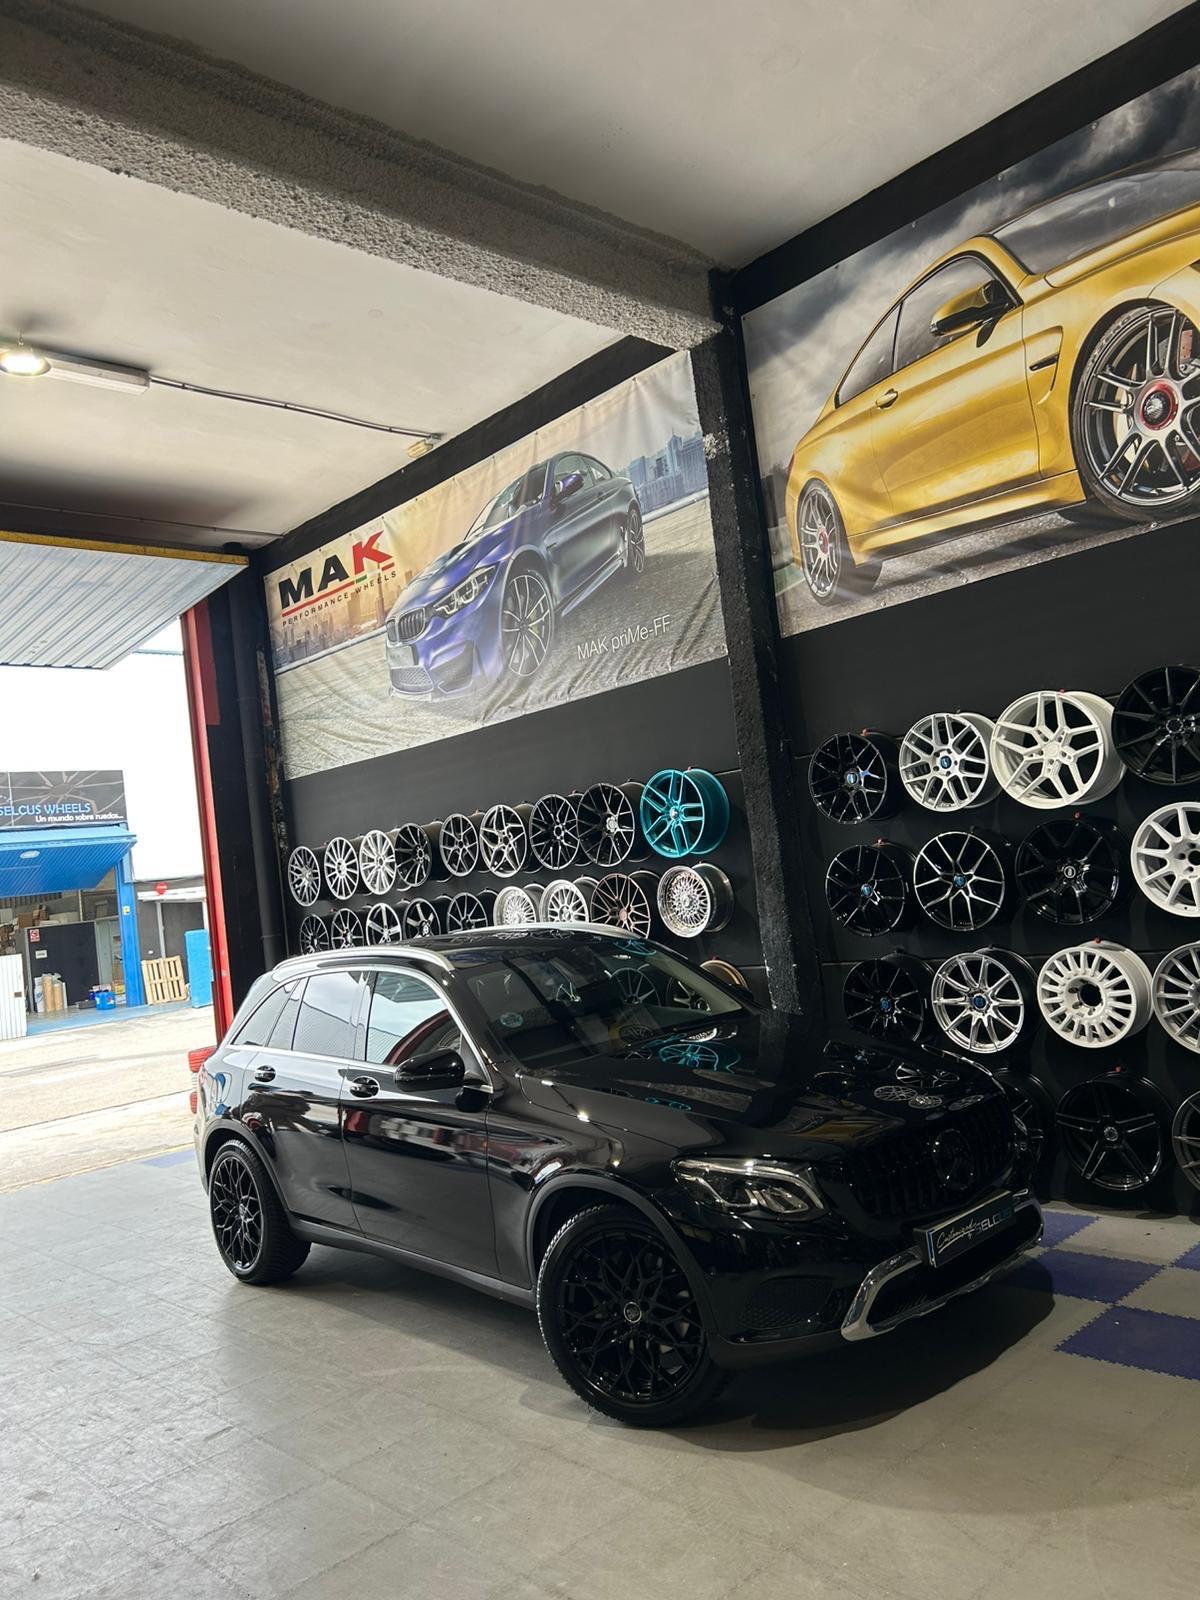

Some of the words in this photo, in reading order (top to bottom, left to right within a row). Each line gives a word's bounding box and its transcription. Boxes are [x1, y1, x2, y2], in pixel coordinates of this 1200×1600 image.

[278, 530, 393, 610] MAK
[282, 592, 350, 627] PERFORMANCE
[354, 570, 397, 595] WHEELS
[577, 636, 609, 660] MAK
[611, 614, 671, 653] priMe-FF
[0, 804, 42, 816] SELCUS
[44, 803, 91, 814] WHEELS
[35, 815, 47, 823] Un
[48, 814, 74, 822] mundo
